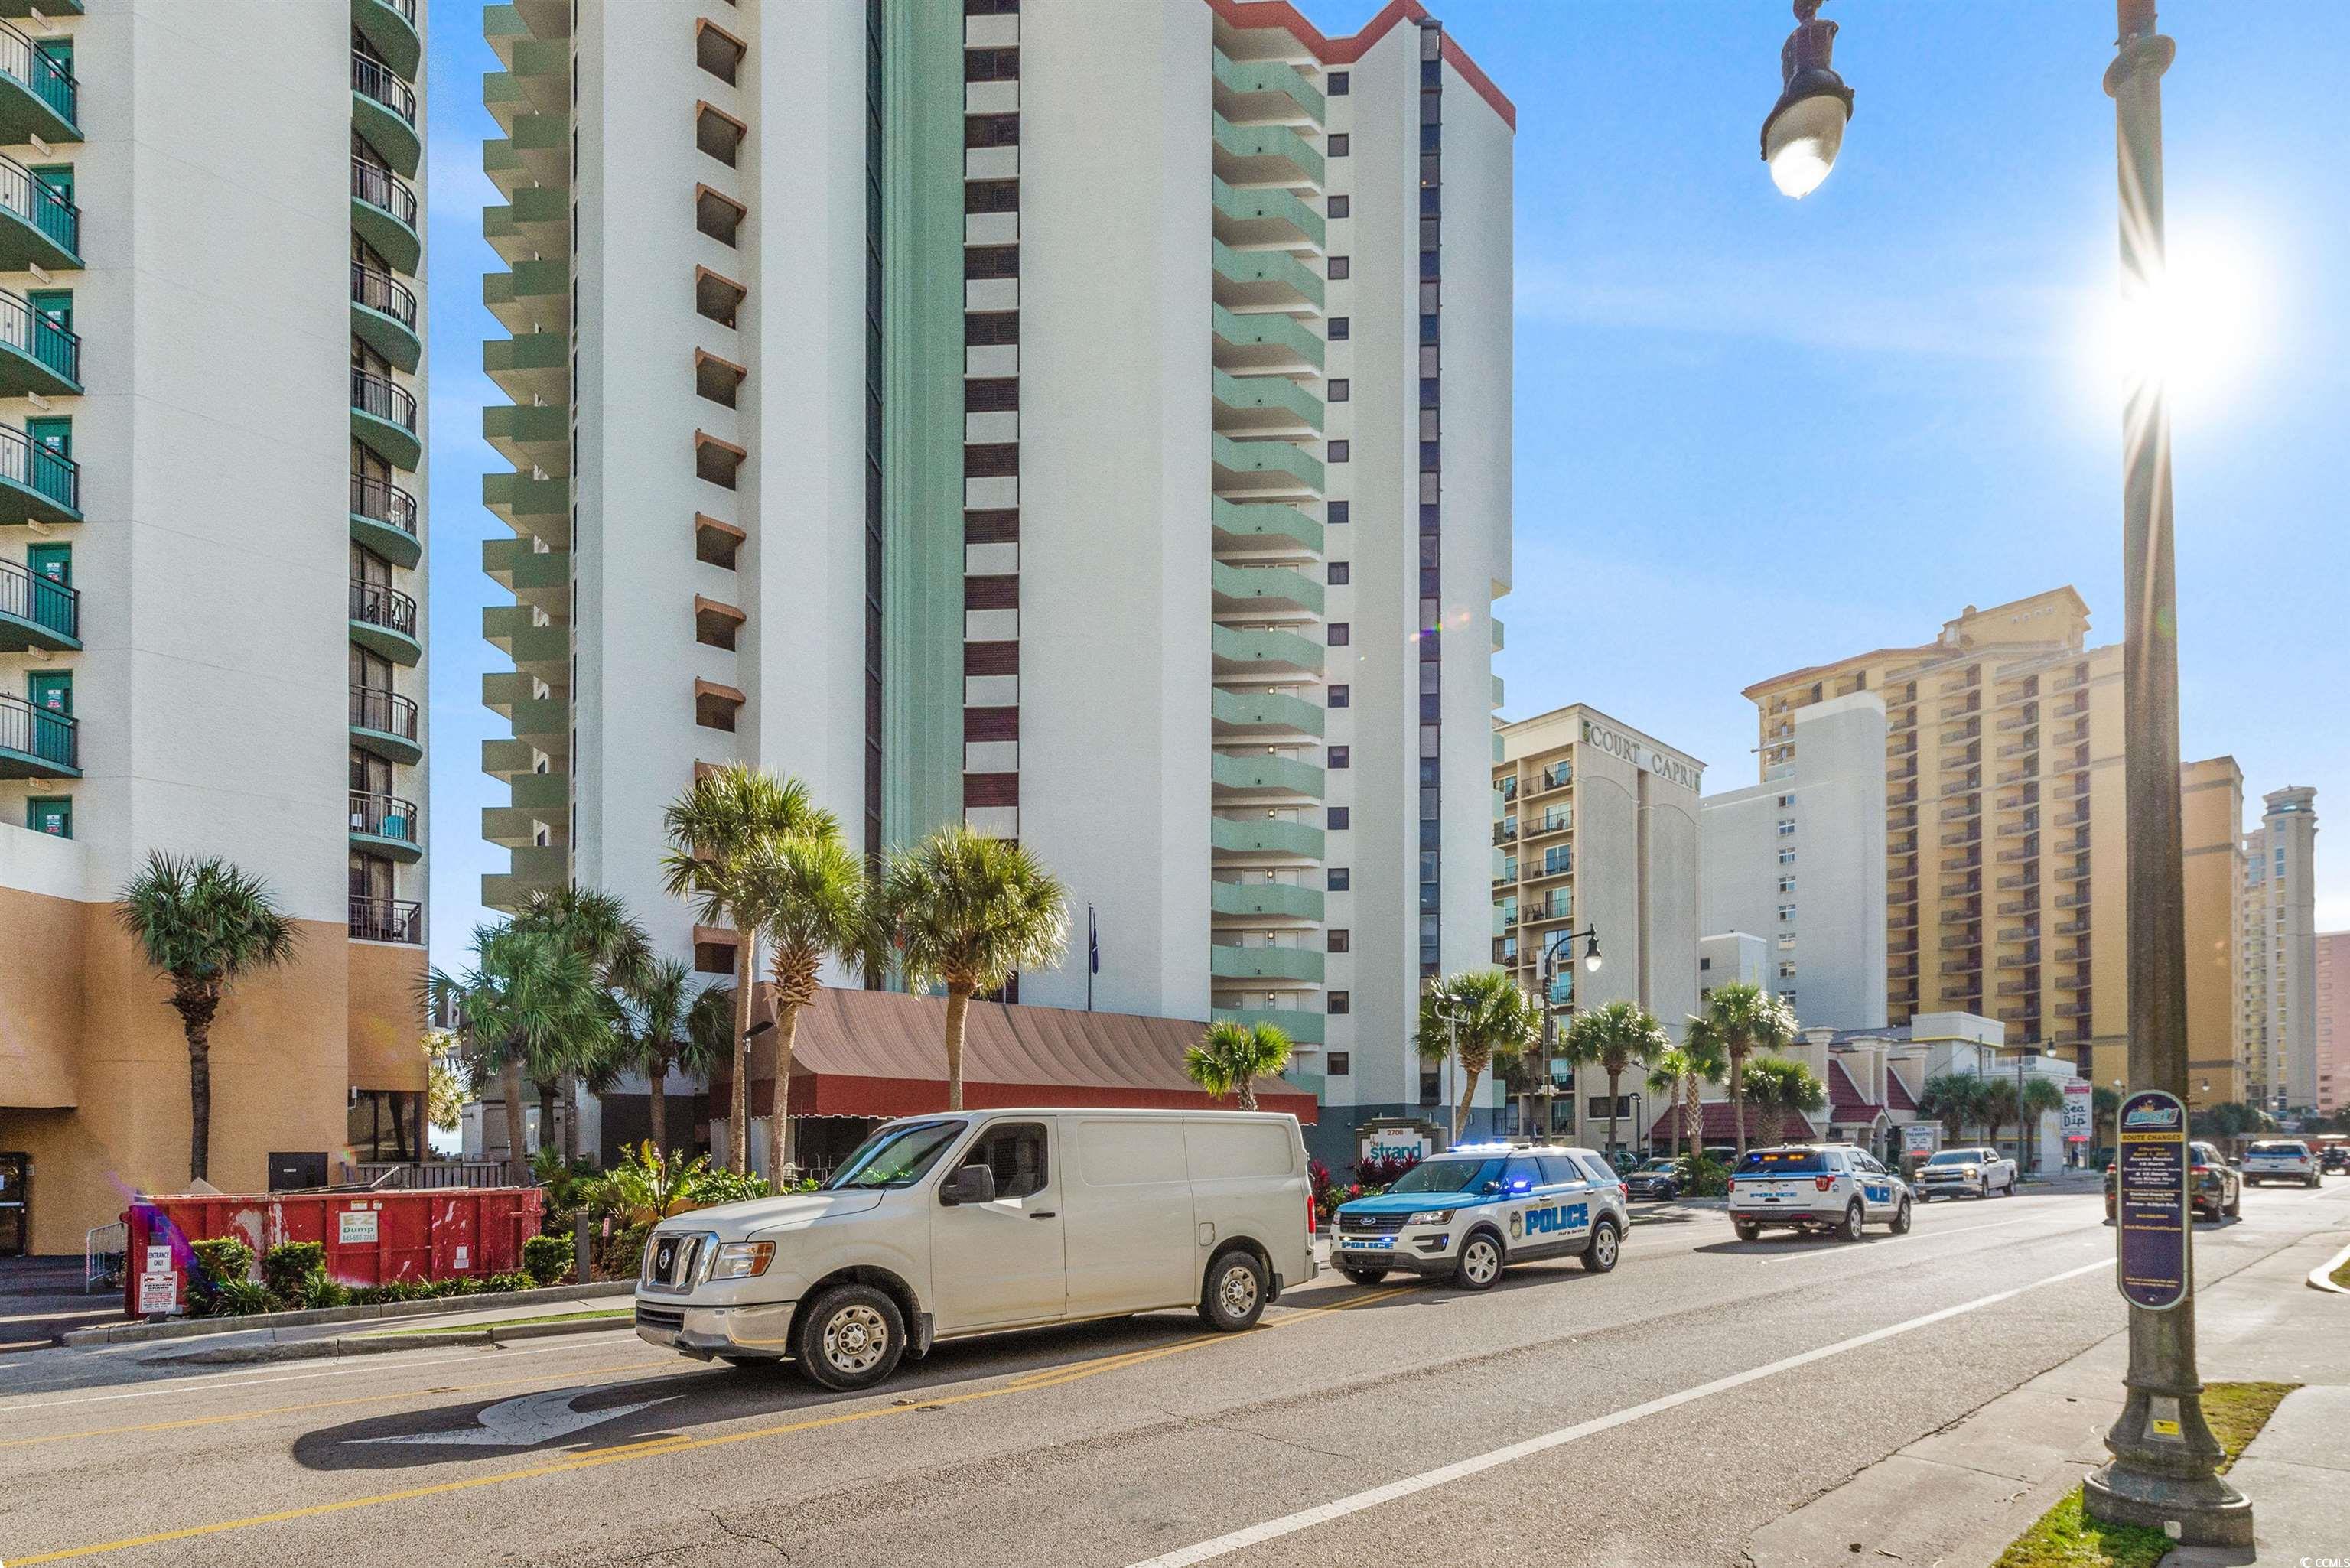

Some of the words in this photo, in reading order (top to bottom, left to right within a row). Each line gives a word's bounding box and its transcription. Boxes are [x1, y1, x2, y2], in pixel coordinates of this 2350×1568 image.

[1591, 727, 1640, 764] COURT
[1652, 754, 1693, 787] CAPRI
[2063, 1104, 2086, 1115] Sea
[2064, 1116, 2086, 1127] Dip
[1370, 1140, 1421, 1160] strand
[343, 1215, 375, 1225] E-Z
[1525, 1203, 1589, 1236] POLICE
